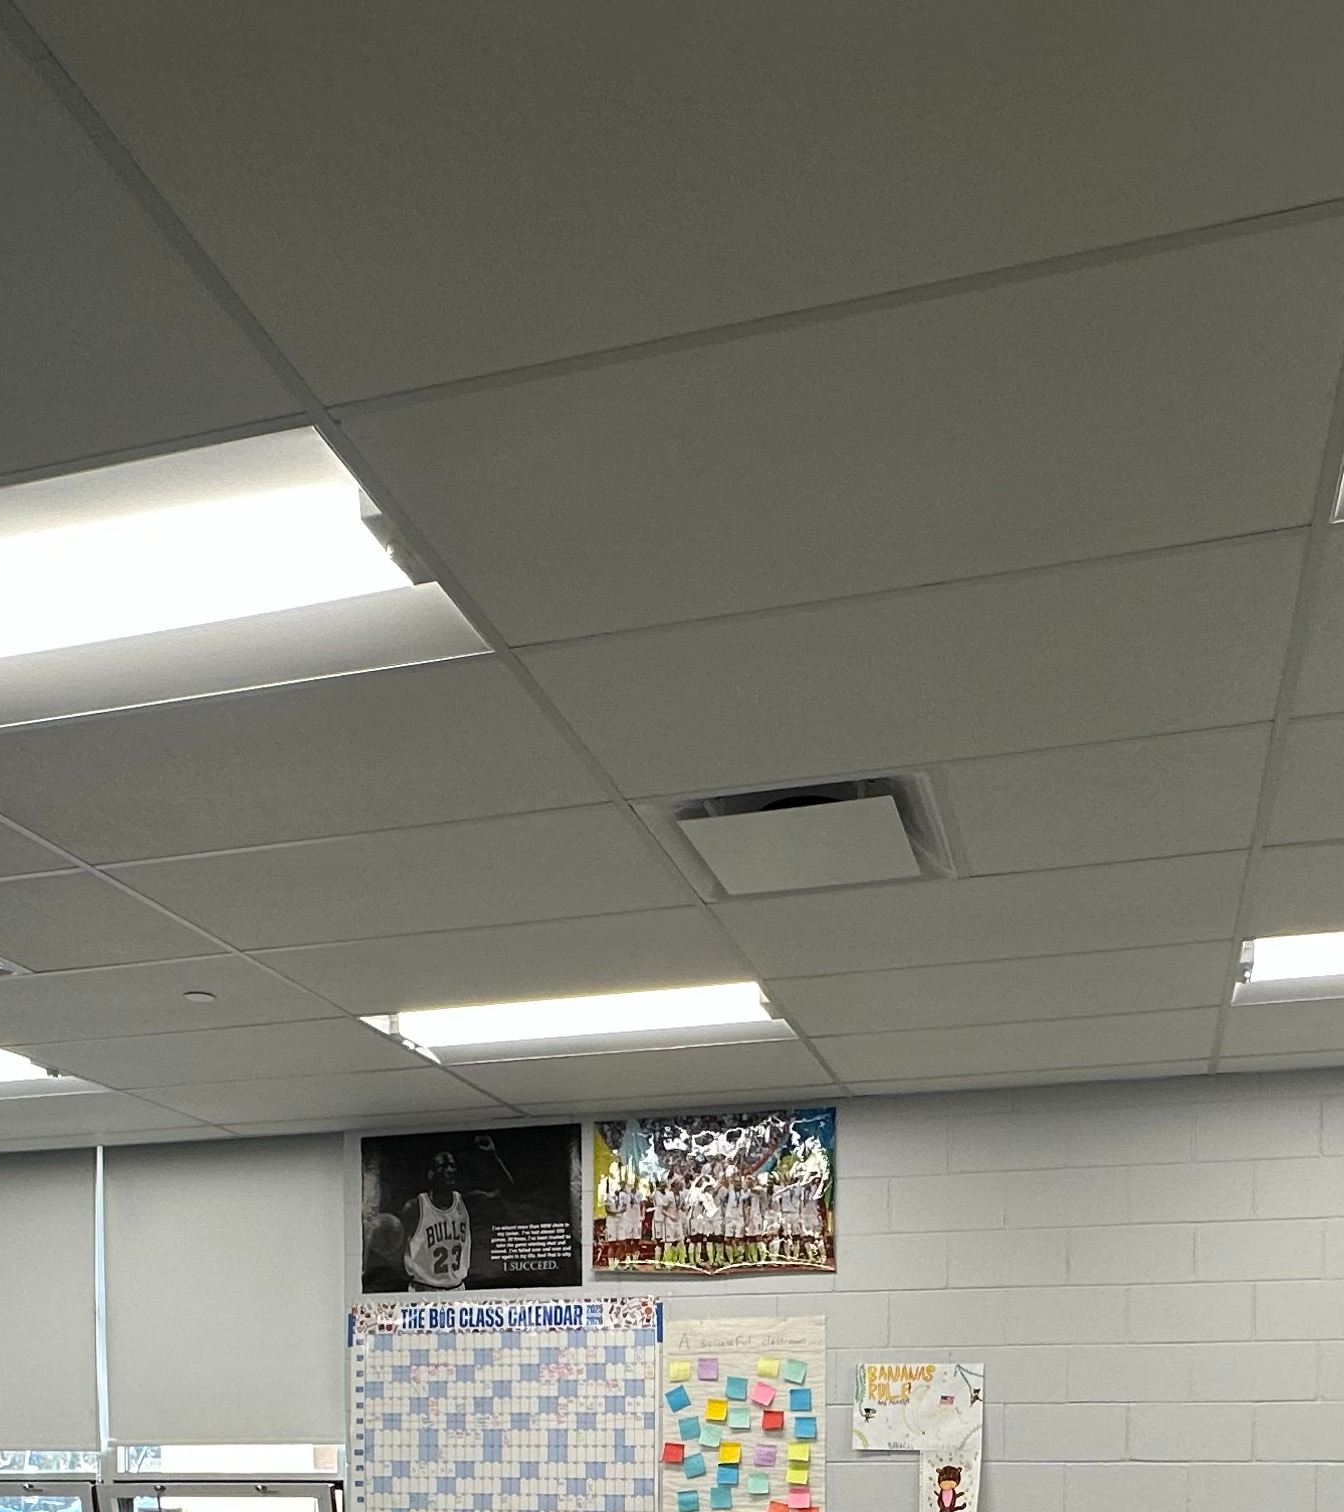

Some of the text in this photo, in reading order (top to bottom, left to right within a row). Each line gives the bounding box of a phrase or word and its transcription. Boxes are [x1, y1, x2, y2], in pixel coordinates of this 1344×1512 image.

[426, 1223, 466, 1248] BULLS
[433, 1245, 462, 1274] 23
[509, 1261, 559, 1271] SUCCEED.
[402, 1304, 583, 1329] THE BIG CLASS CALENDAR
[679, 1332, 690, 1349] A
[867, 1365, 936, 1382] BANANAS
